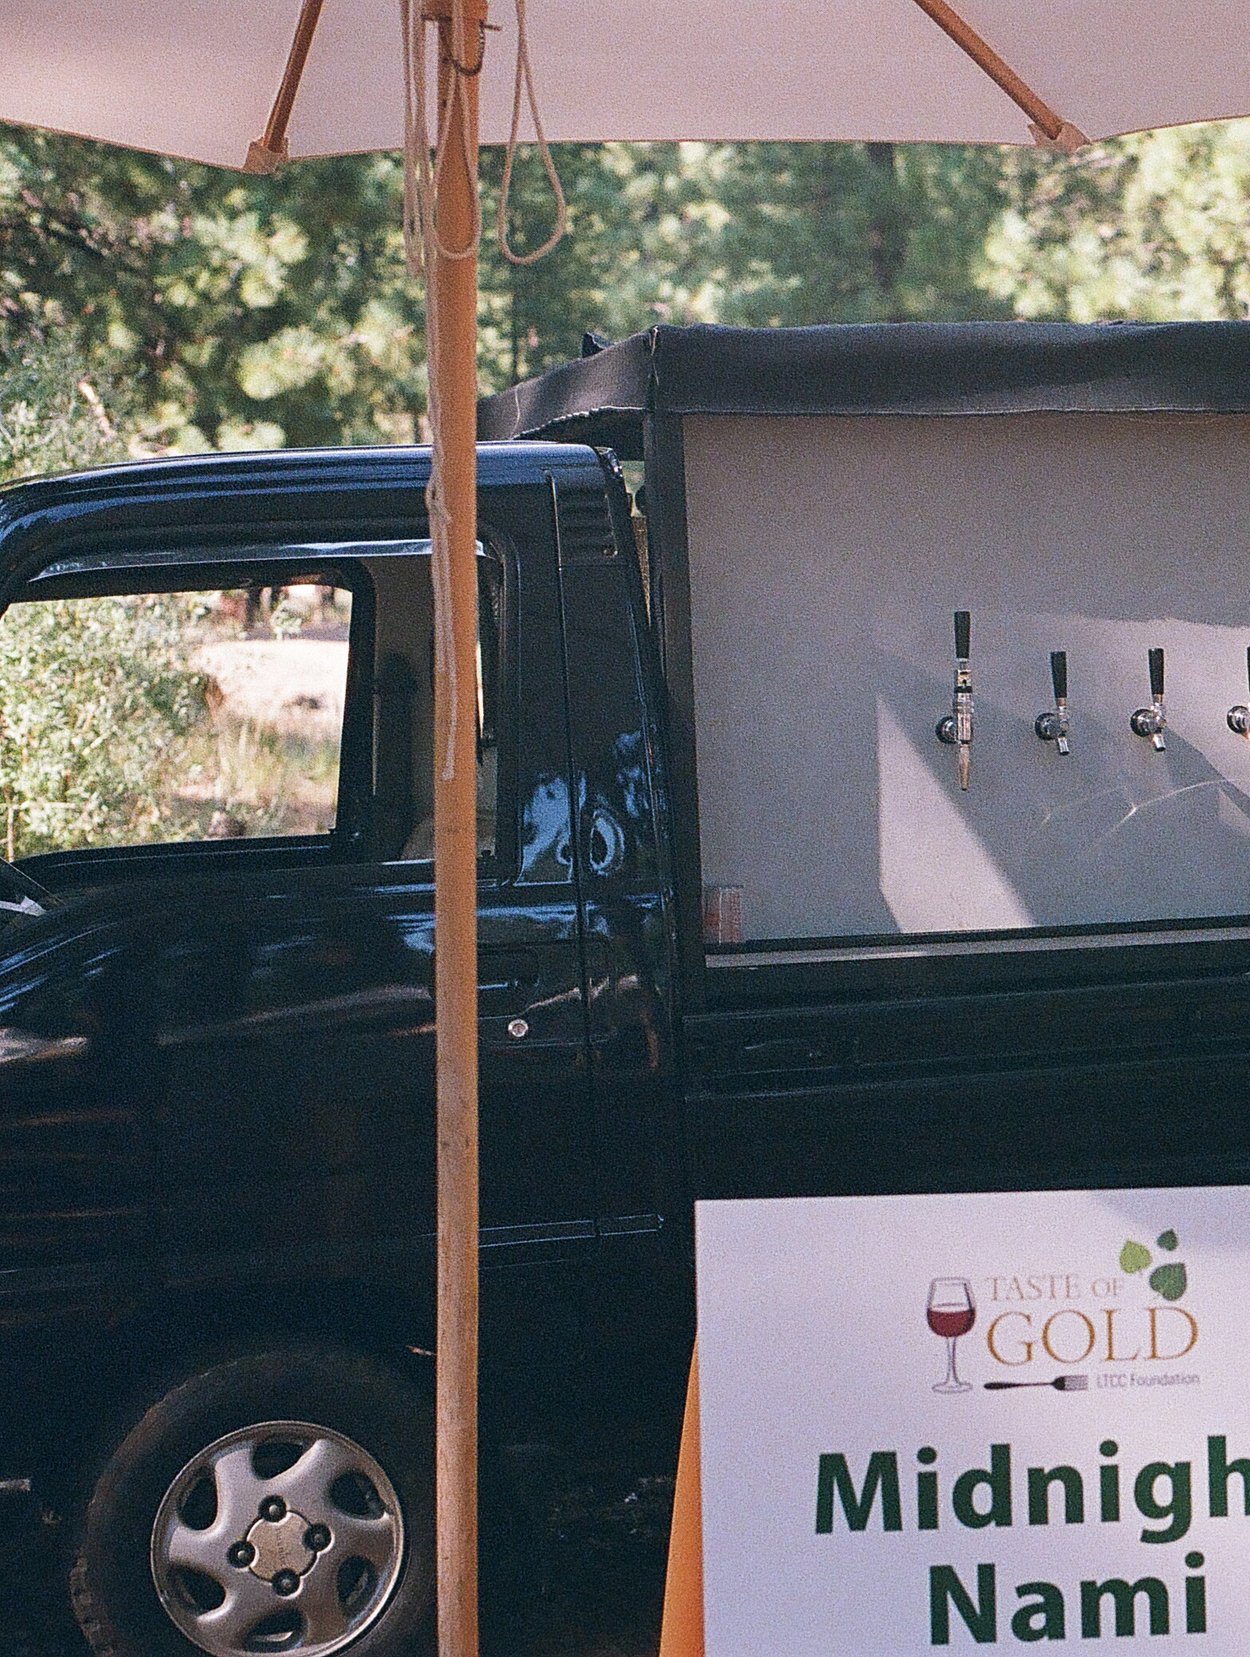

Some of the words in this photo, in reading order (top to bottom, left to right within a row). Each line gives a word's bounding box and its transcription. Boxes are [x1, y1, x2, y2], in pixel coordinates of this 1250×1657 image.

[986, 1273, 1080, 1301] TASTE
[1090, 1277, 1125, 1297] OF
[986, 1306, 1199, 1366] GOLD
[1097, 1373, 1128, 1389] LTCC
[1130, 1371, 1200, 1387] Foundation
[928, 1551, 1207, 1646] Nami
